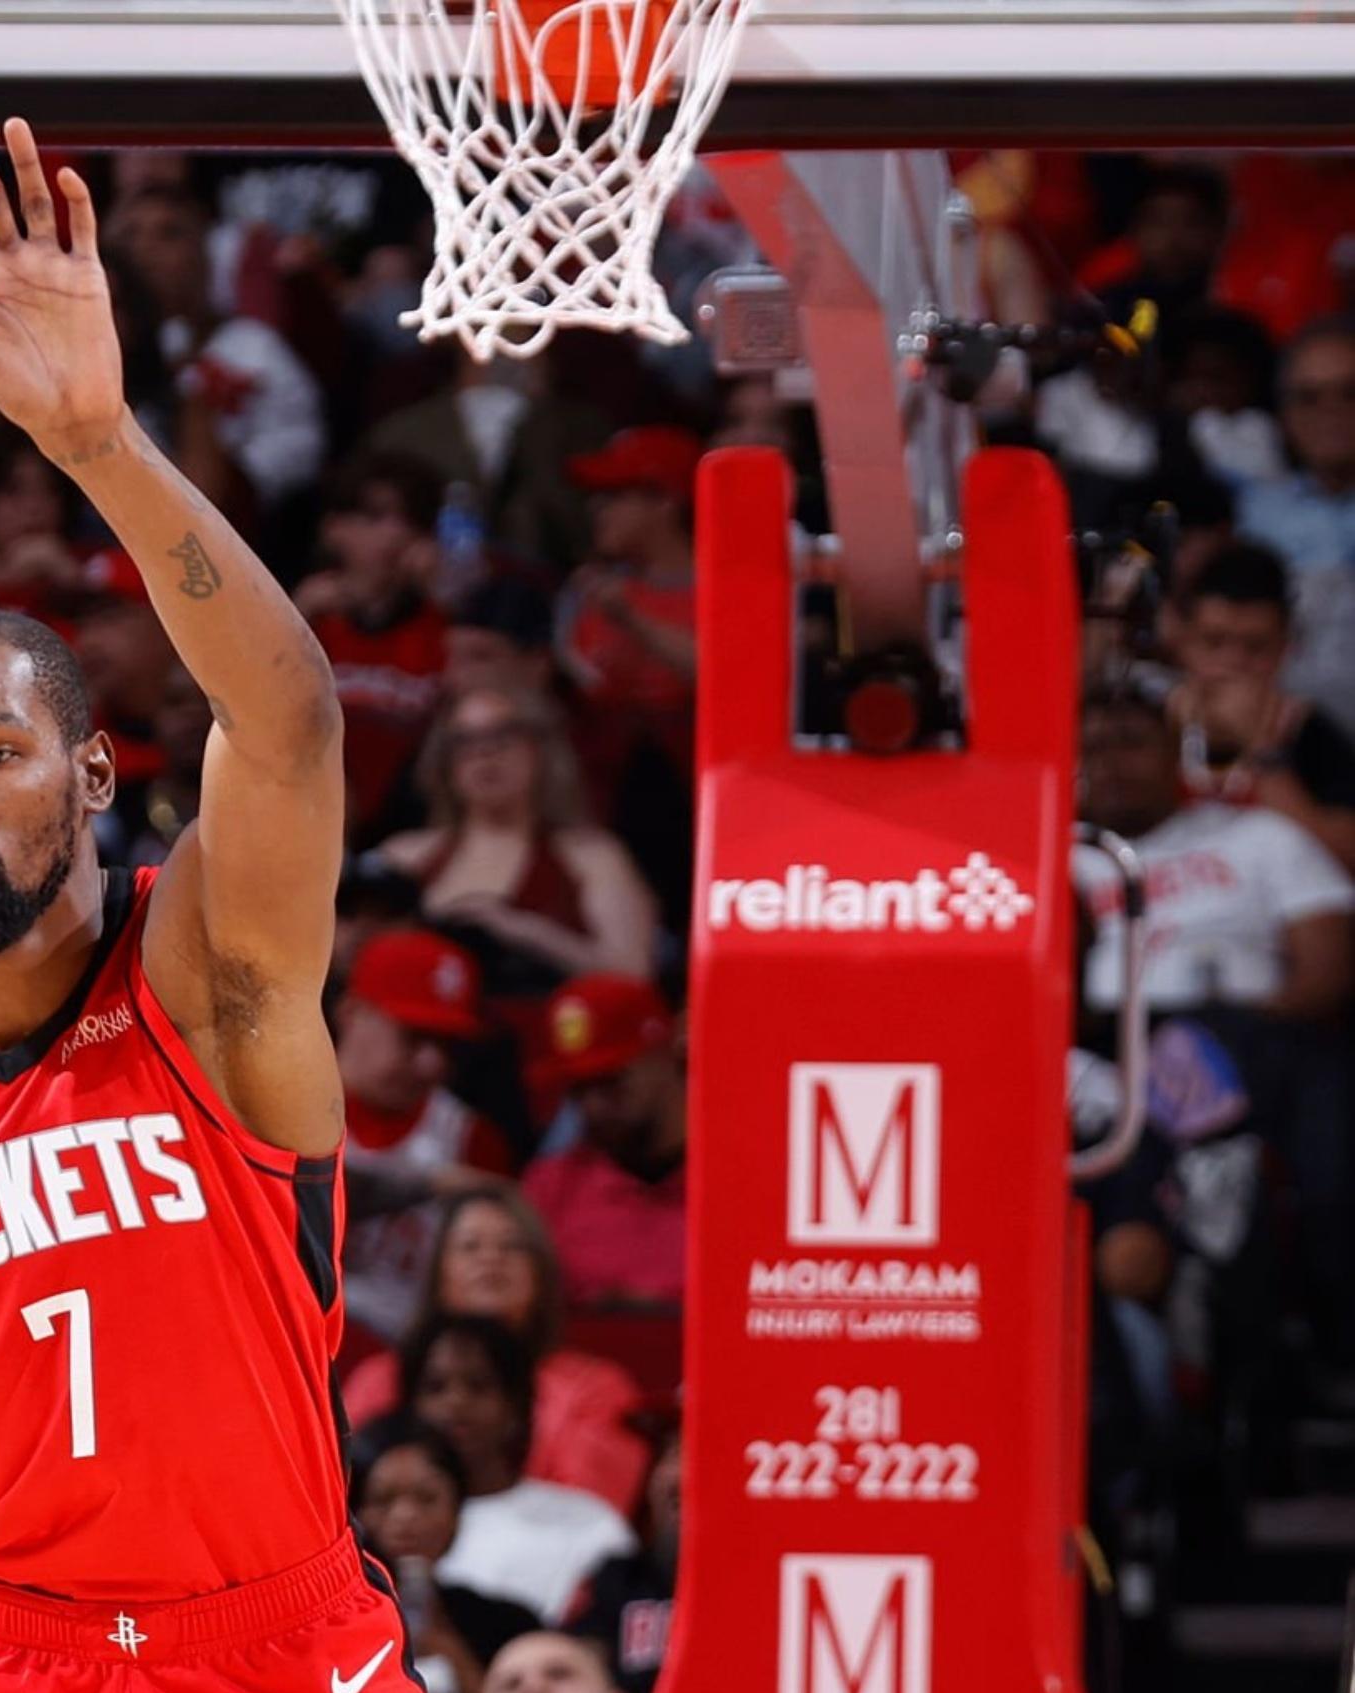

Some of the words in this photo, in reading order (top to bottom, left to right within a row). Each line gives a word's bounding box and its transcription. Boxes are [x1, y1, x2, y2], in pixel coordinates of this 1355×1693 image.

[708, 864, 952, 933] reliant
[802, 1073, 920, 1232] M
[748, 1258, 982, 1299] MOKARAM
[746, 1308, 843, 1340] INJURY
[846, 1309, 982, 1343] LAWYERS
[20, 1288, 97, 1459] 7
[813, 1384, 902, 1441] 281
[744, 1439, 980, 1500] 222-2222
